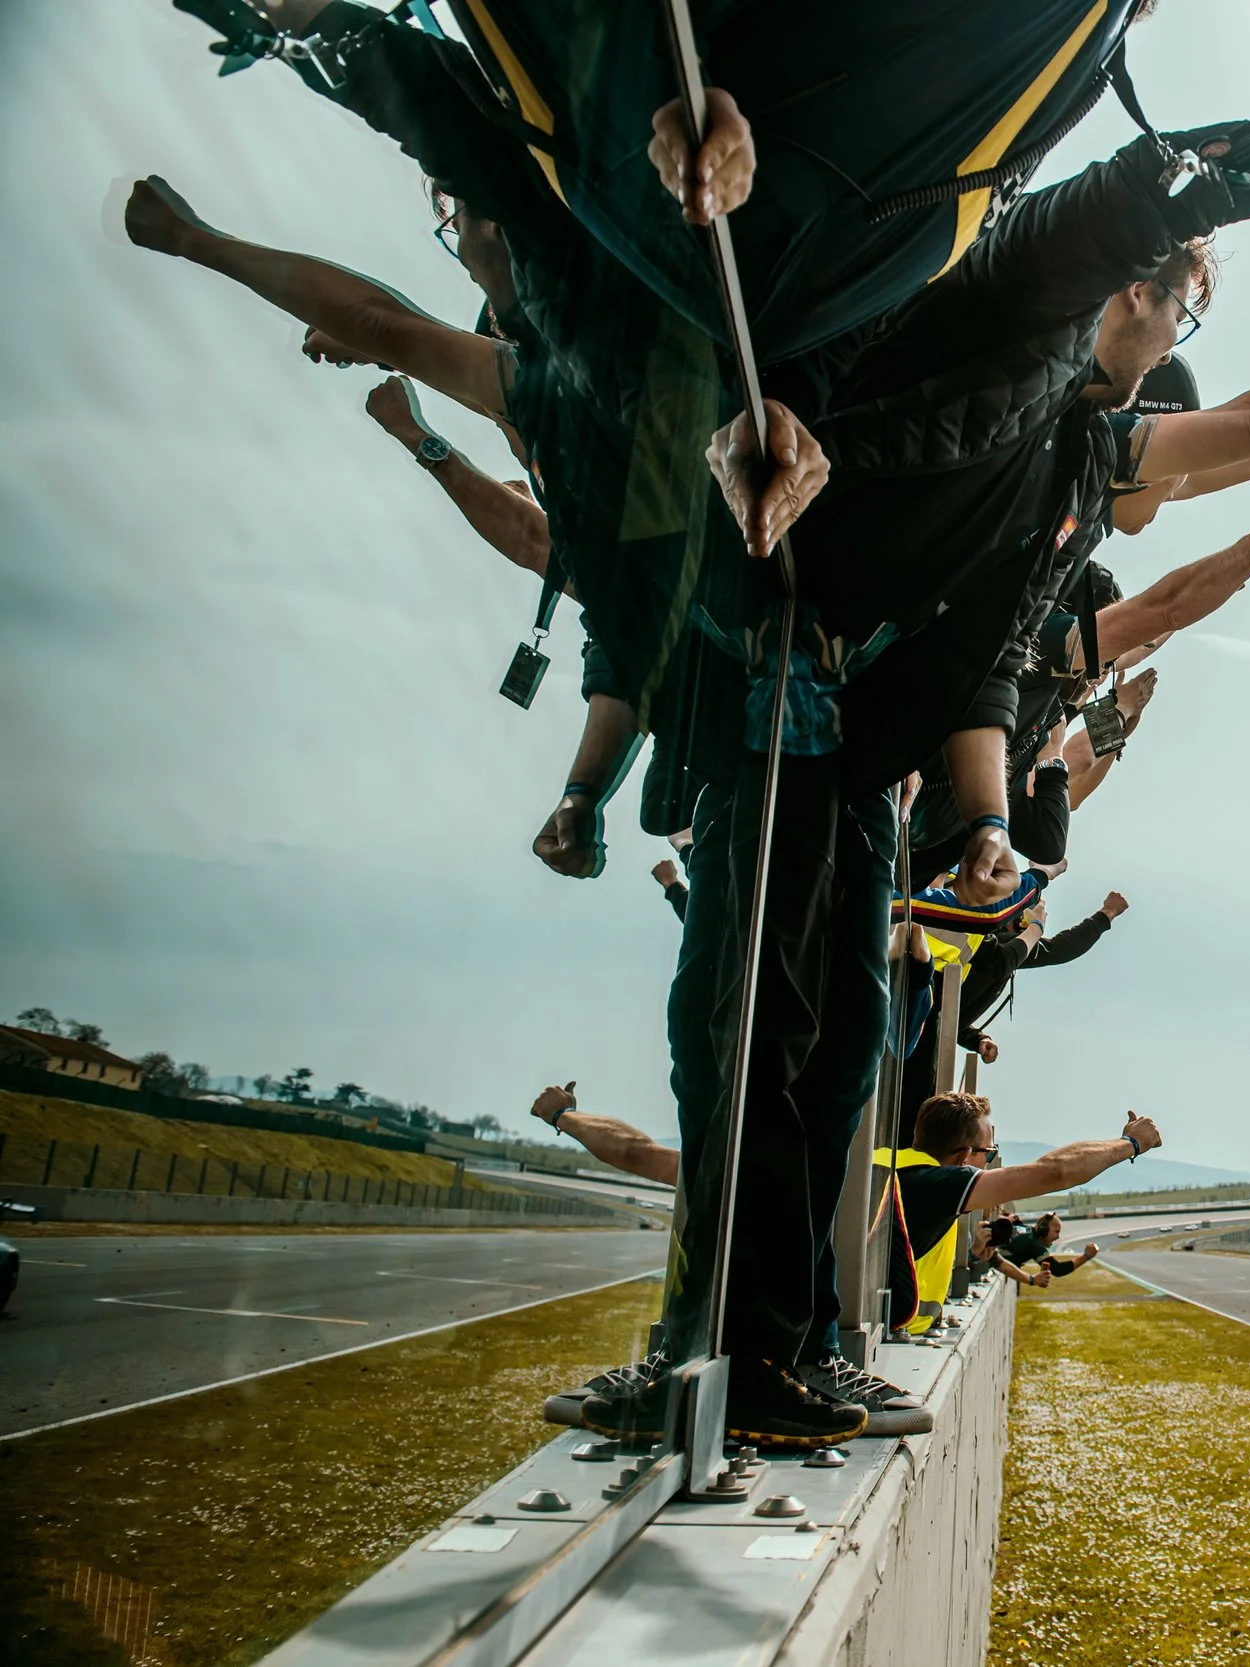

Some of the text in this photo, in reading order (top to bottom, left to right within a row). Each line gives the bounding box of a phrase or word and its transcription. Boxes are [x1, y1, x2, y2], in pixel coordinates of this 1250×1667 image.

[1139, 400, 1183, 411] BMW M4 GT3
